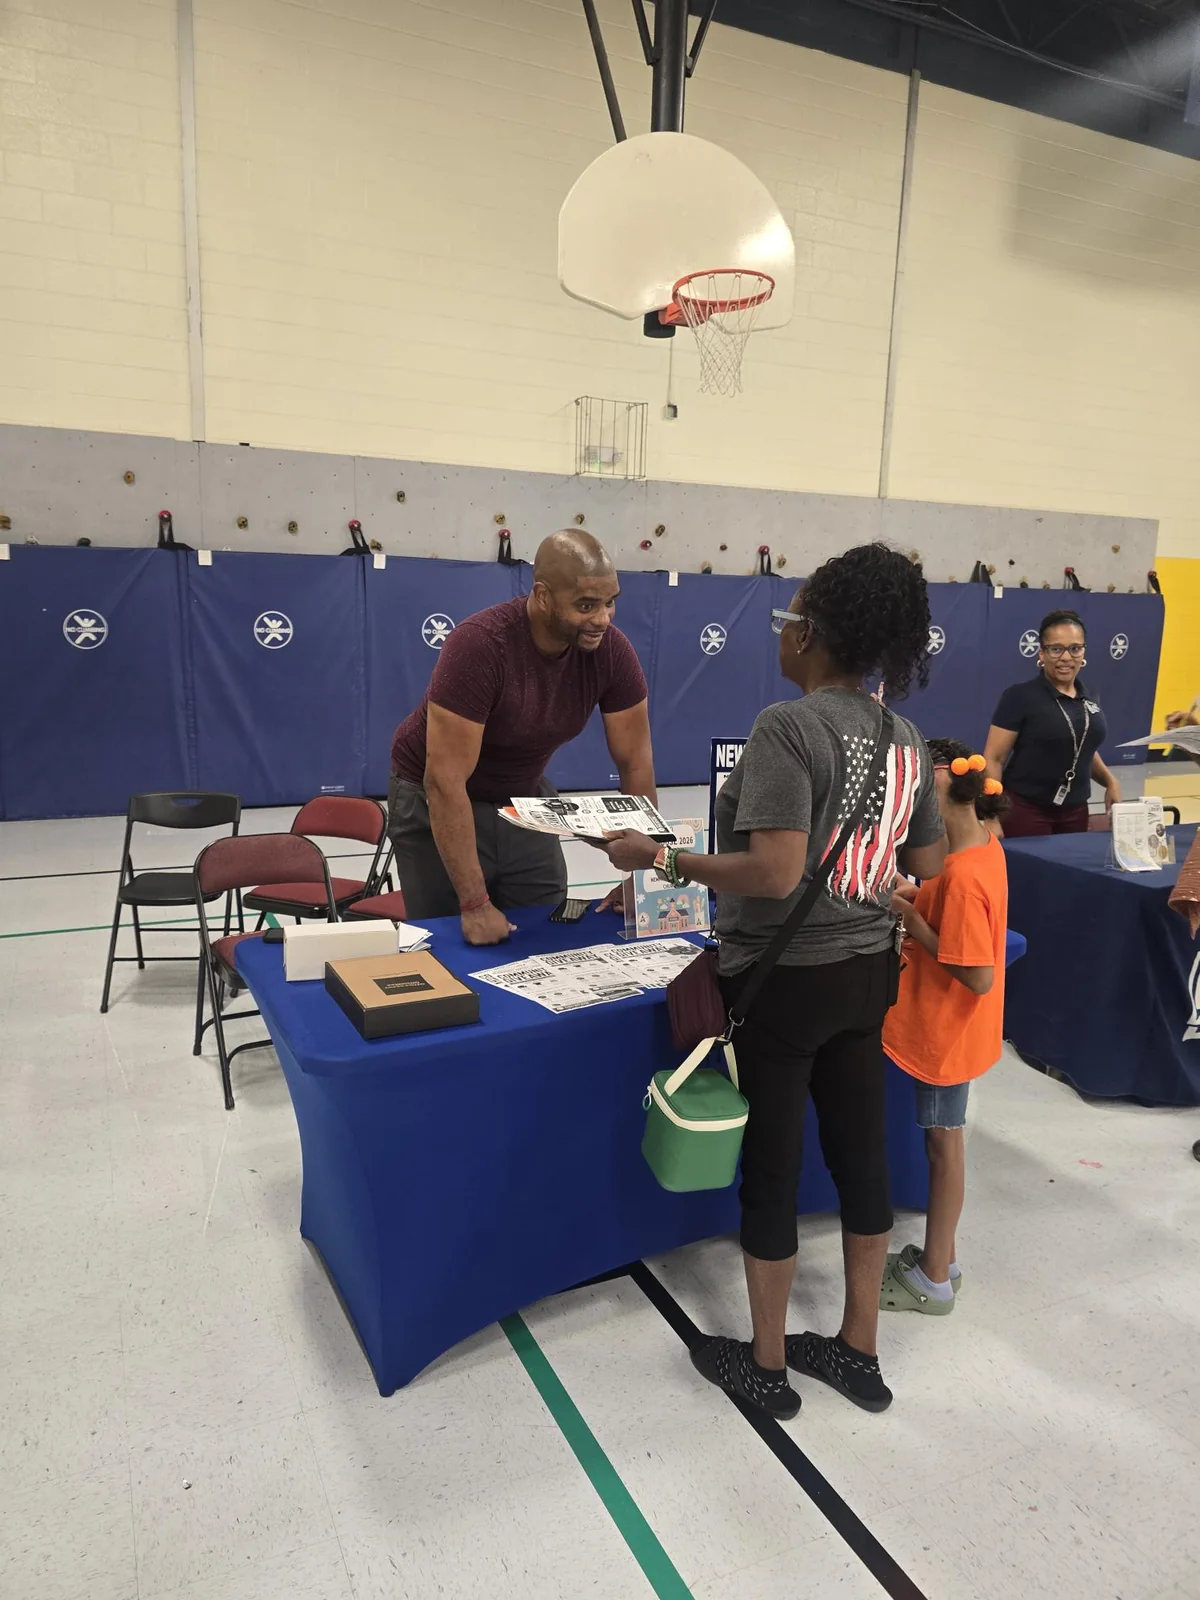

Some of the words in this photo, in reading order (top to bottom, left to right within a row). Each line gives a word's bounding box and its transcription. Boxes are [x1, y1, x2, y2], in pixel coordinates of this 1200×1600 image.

[679, 836, 693, 845] 2026
[610, 943, 662, 954] COMMUNITY
[540, 951, 594, 962] COMMUNITY
[497, 968, 547, 980] COMMUNIT
